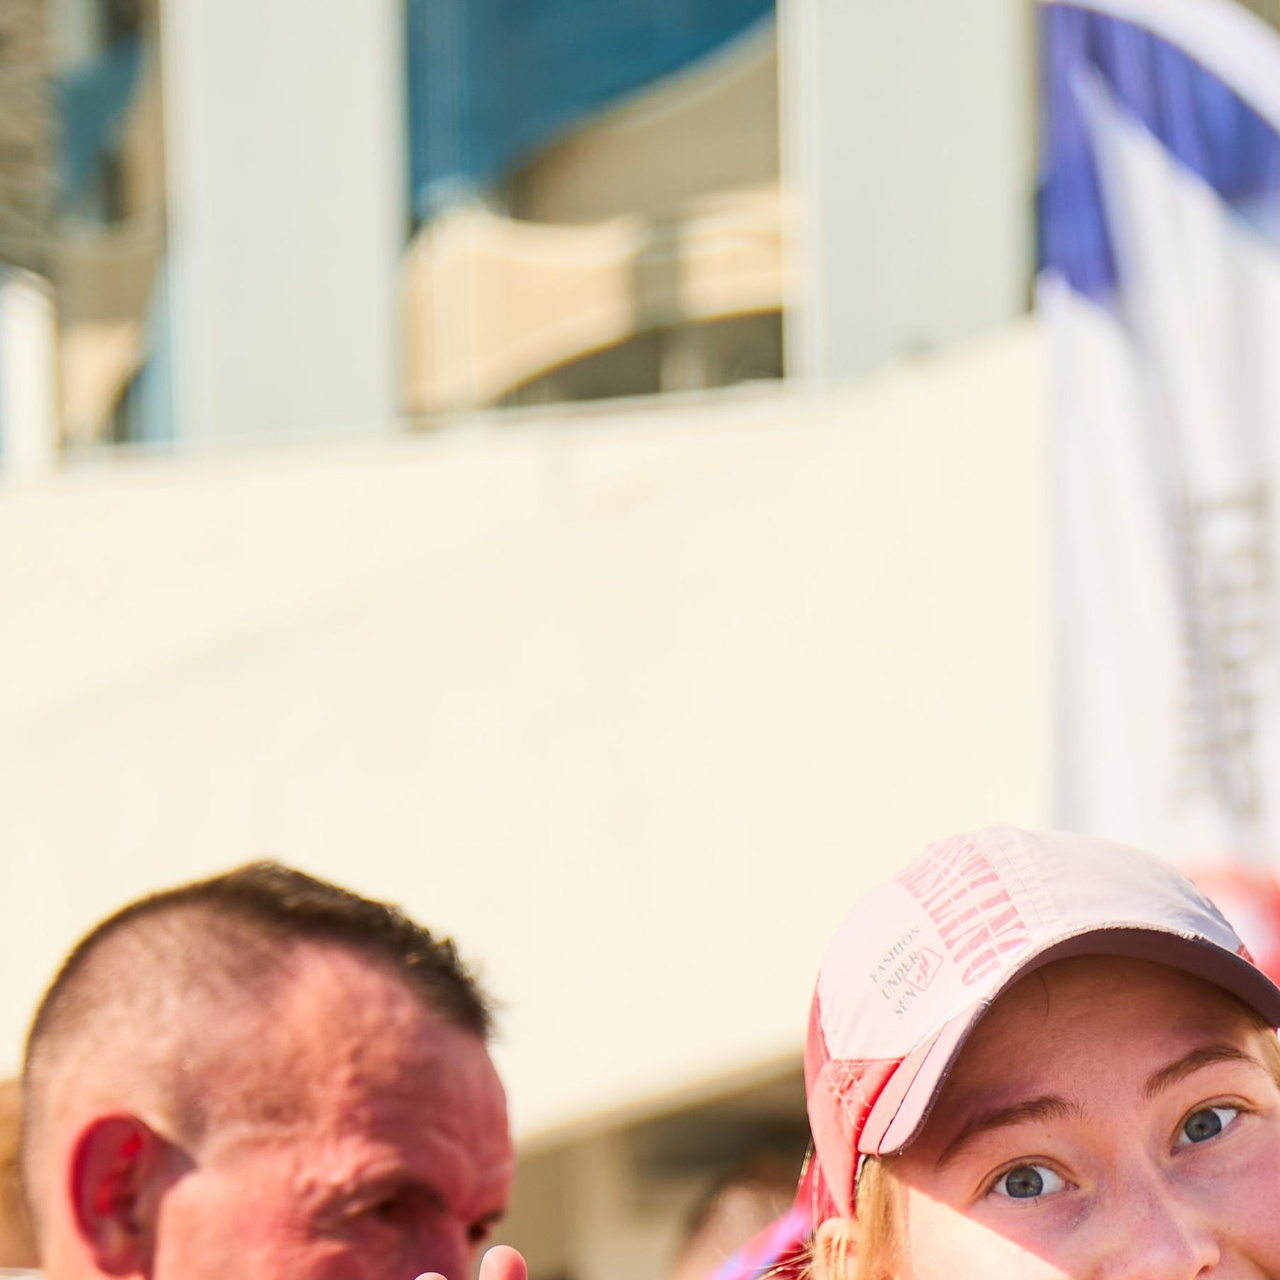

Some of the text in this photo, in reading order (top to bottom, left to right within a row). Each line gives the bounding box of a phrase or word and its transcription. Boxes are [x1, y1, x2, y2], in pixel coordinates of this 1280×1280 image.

[869, 926, 920, 984] FASHION
[881, 951, 920, 1000] UNDER
[894, 986, 917, 1020] SUN
